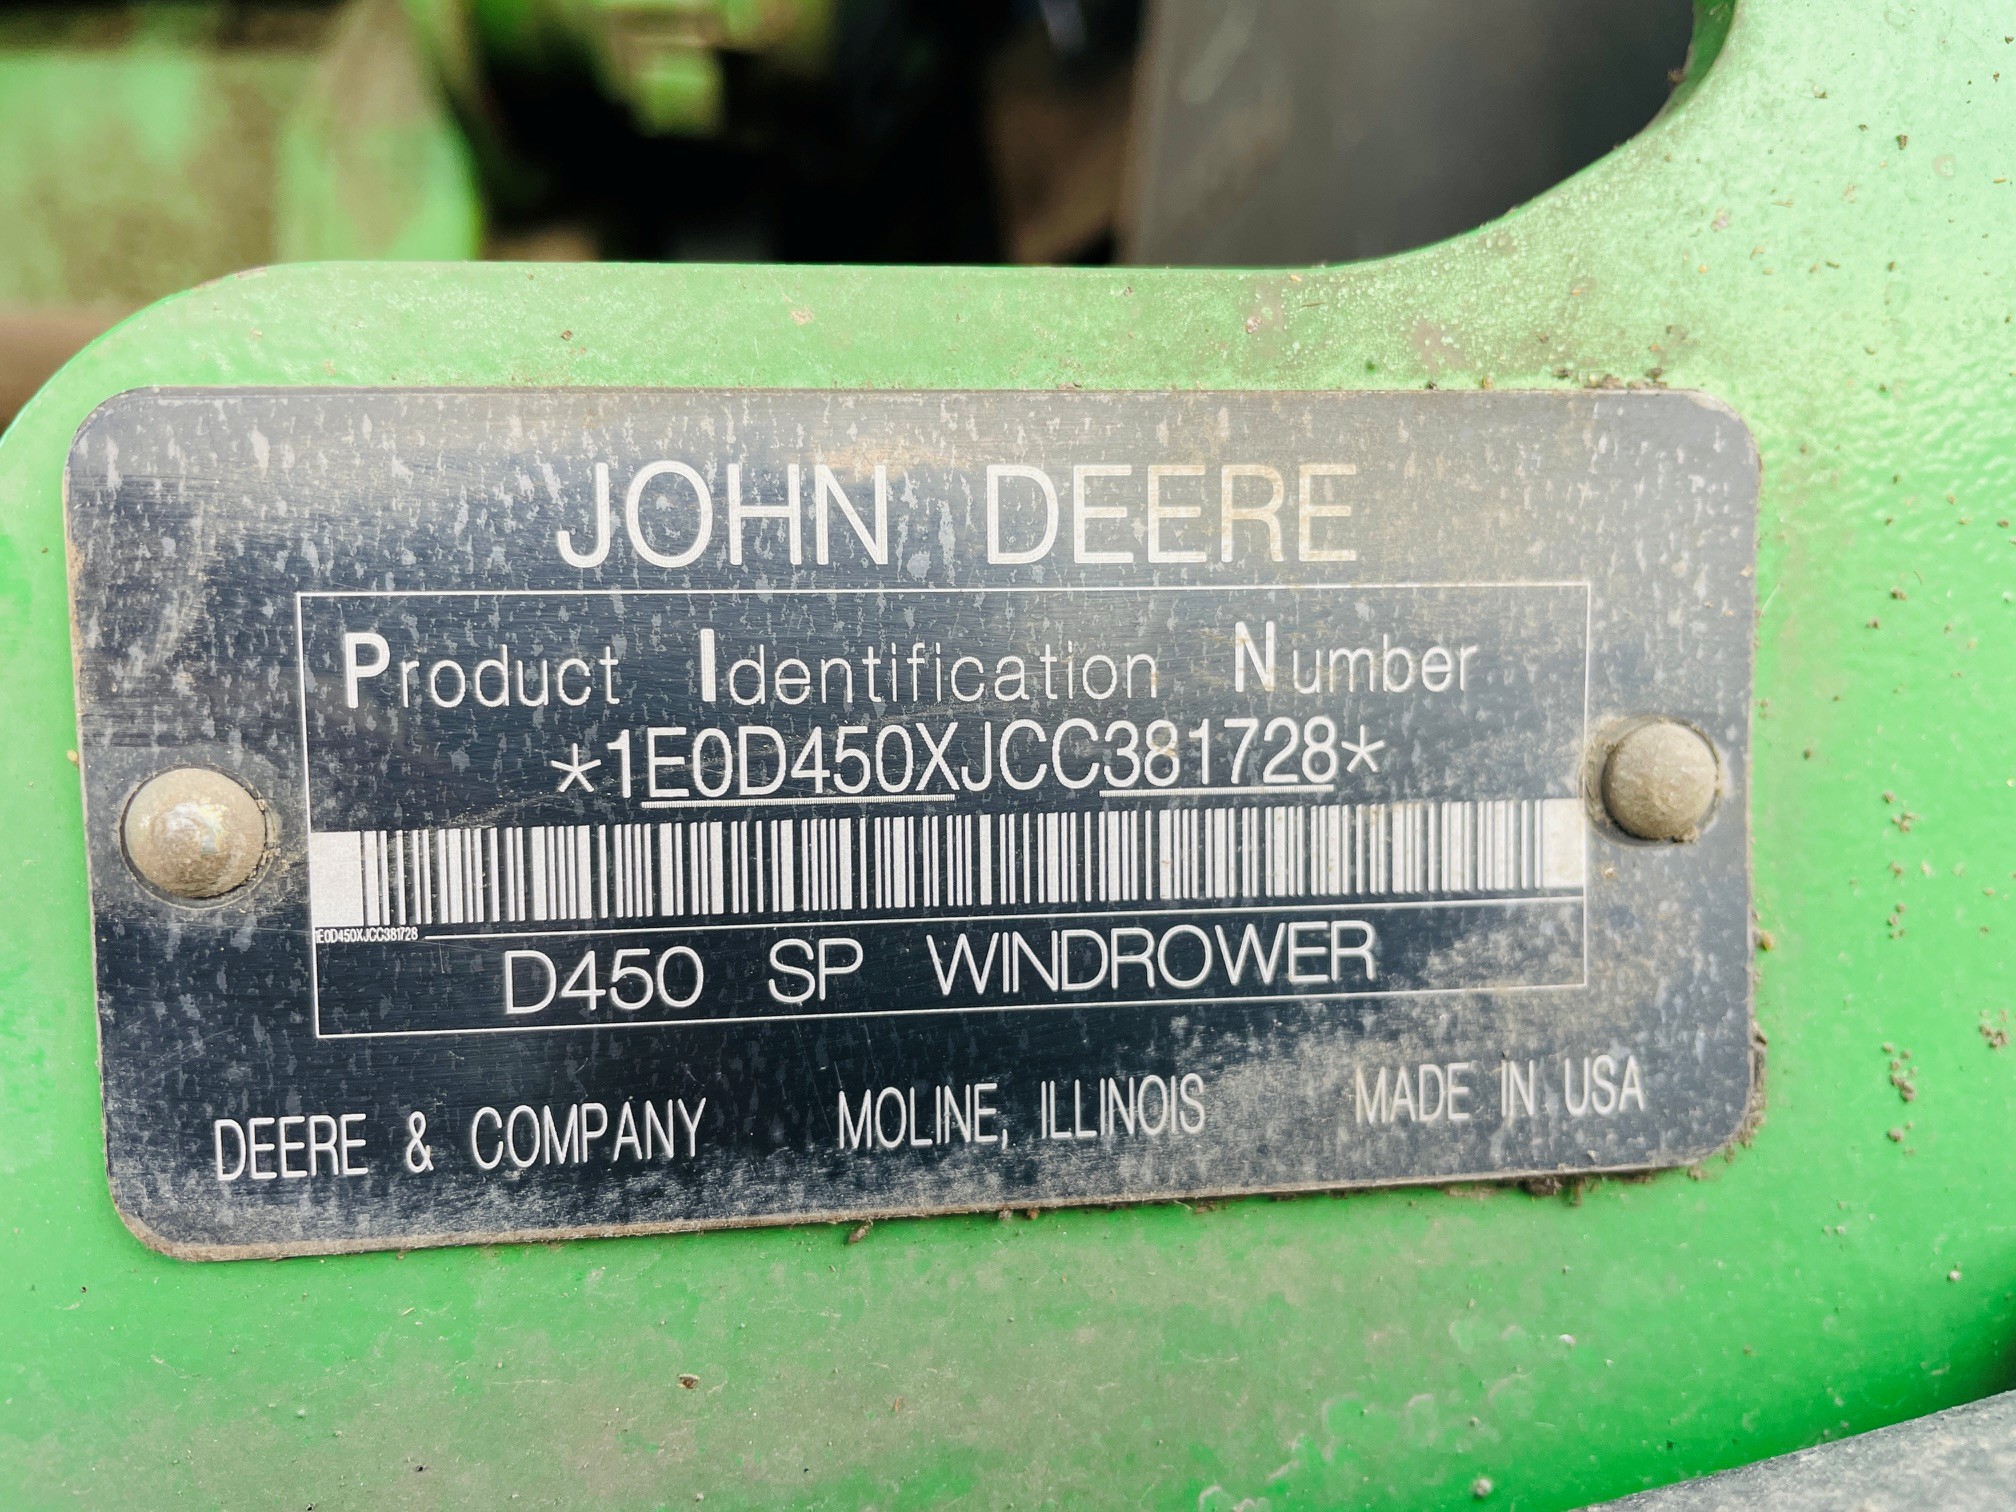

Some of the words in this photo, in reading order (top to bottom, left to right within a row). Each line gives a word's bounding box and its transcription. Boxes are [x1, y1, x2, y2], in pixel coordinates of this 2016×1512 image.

[555, 460, 889, 569] JOHN
[986, 464, 1358, 566] DEERE
[343, 631, 620, 709] Product
[699, 628, 1159, 705] Identification
[1233, 620, 1479, 695] Number
[504, 945, 704, 1017] D450
[768, 938, 864, 1004] SP
[926, 920, 1378, 996] WINDROWER
[213, 1112, 369, 1182] DEERE
[405, 1110, 433, 1173] &
[470, 1097, 707, 1171] COMPANY
[838, 1081, 1010, 1150] MOLINE,
[1040, 1072, 1206, 1140] ILLINOIS
[1354, 1061, 1470, 1125] MADE
[1501, 1058, 1537, 1118] IN
[1565, 1055, 1646, 1117] USA
